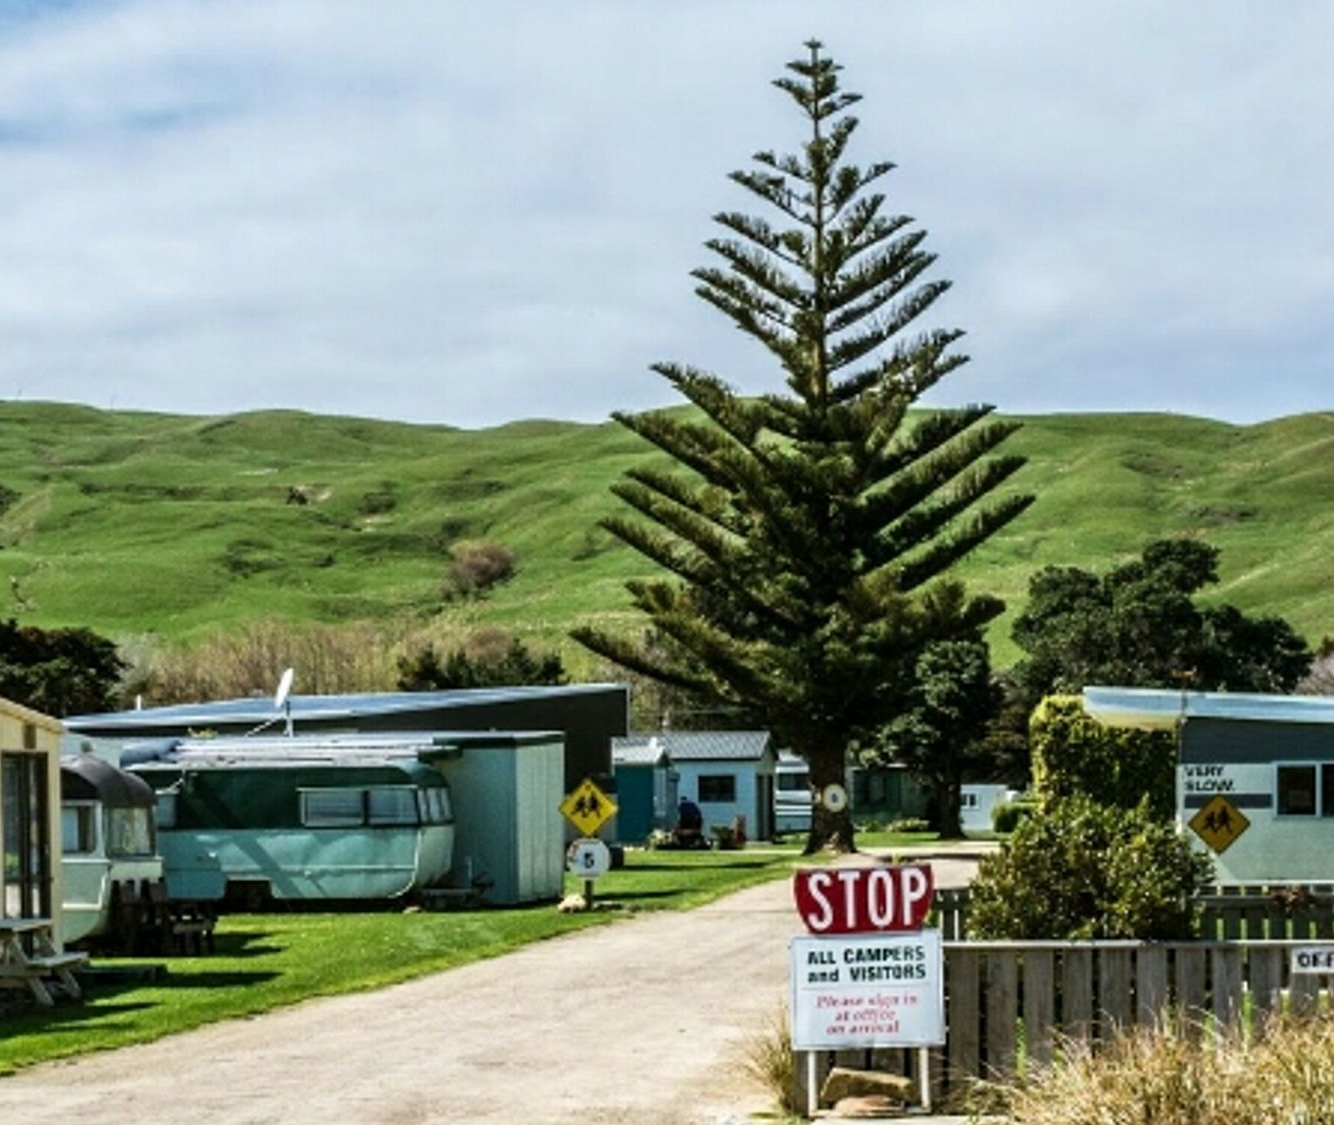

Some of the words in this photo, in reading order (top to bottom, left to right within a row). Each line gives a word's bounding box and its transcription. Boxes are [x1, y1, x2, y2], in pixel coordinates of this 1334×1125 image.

[807, 867, 927, 931] STOP
[807, 949, 836, 965] ALL
[843, 945, 926, 964] CAMPERS
[807, 967, 839, 983] and
[849, 963, 927, 982] VISITORS
[903, 992, 918, 1005] in
[826, 1025, 846, 1035] on
[849, 1020, 899, 1034] arrival
